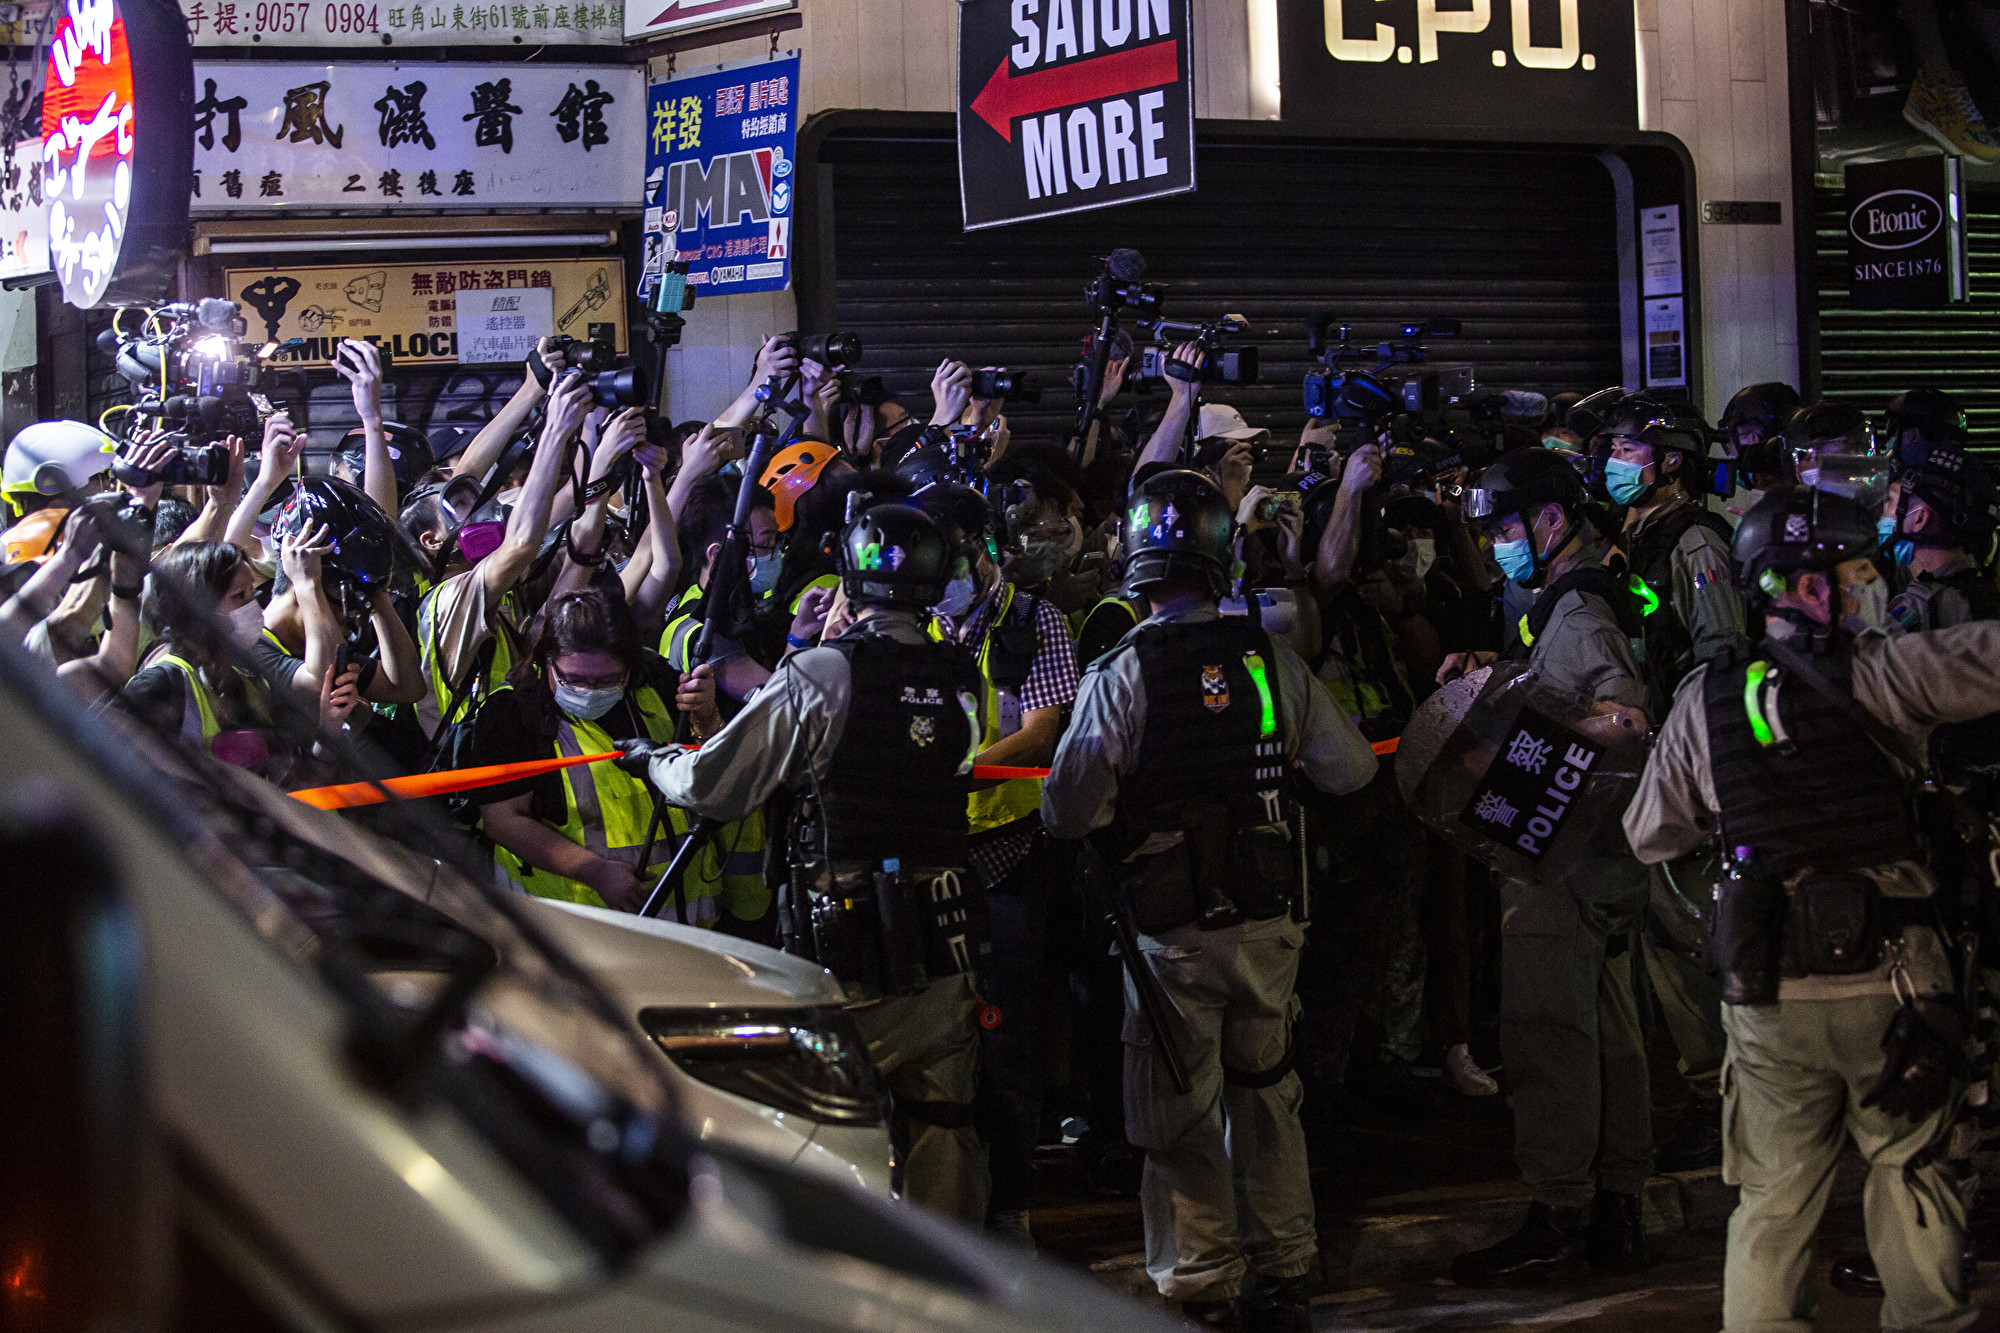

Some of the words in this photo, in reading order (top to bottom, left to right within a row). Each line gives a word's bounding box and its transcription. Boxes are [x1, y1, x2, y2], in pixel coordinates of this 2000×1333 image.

[325, 3, 379, 34] 0984
[652, 95, 702, 155] 祥發
[1022, 90, 1168, 199] MORE
[342, 168, 476, 197] 二樓後座
[1703, 203, 1750, 221] 59-65
[1868, 203, 1927, 235] Etonic
[720, 266, 744, 282] YAMAHA
[1855, 258, 1942, 280] SINCE1876
[900, 695, 944, 705] POLICE
[1474, 729, 1554, 829] 警察
[1516, 742, 1597, 855] POLICE
